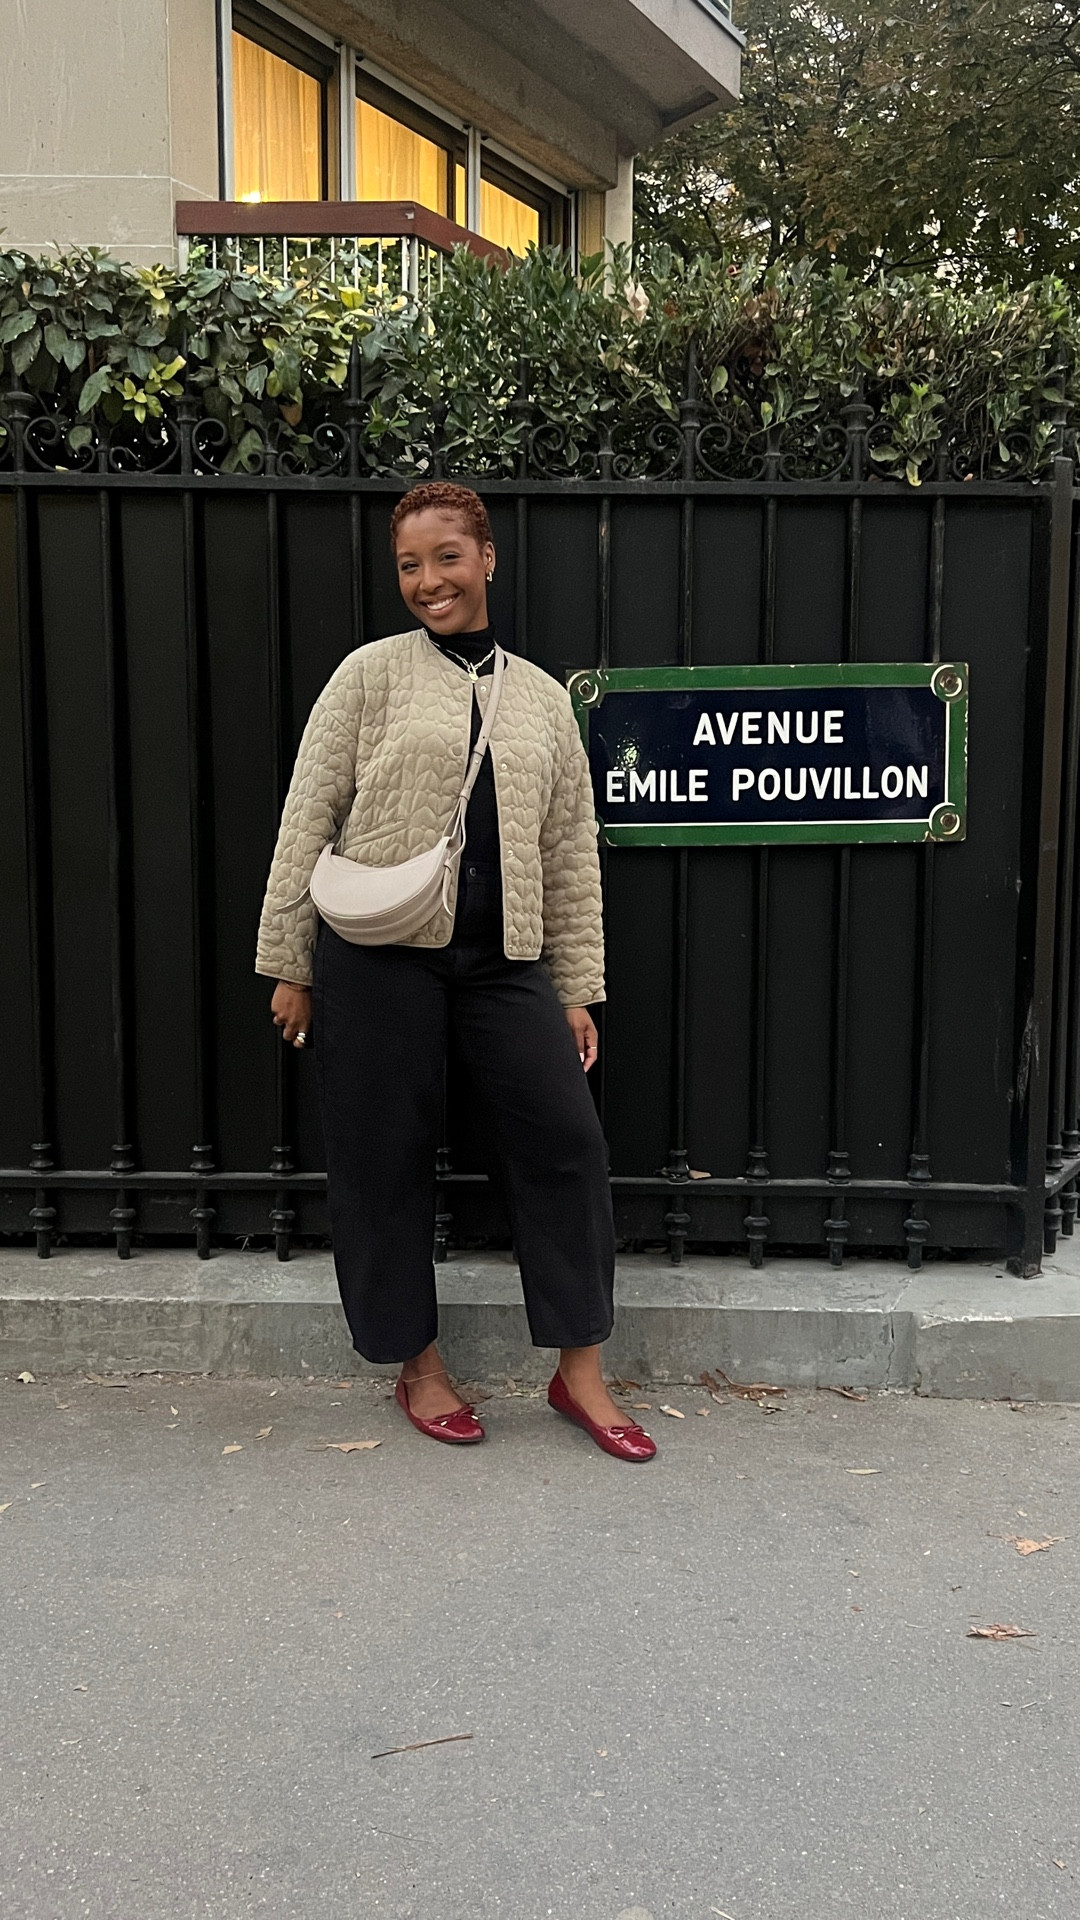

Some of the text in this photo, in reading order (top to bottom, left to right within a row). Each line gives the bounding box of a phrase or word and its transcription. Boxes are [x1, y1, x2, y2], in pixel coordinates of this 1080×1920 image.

[692, 710, 844, 745] AVENUE
[606, 766, 929, 803] EMILE POUVILLON
